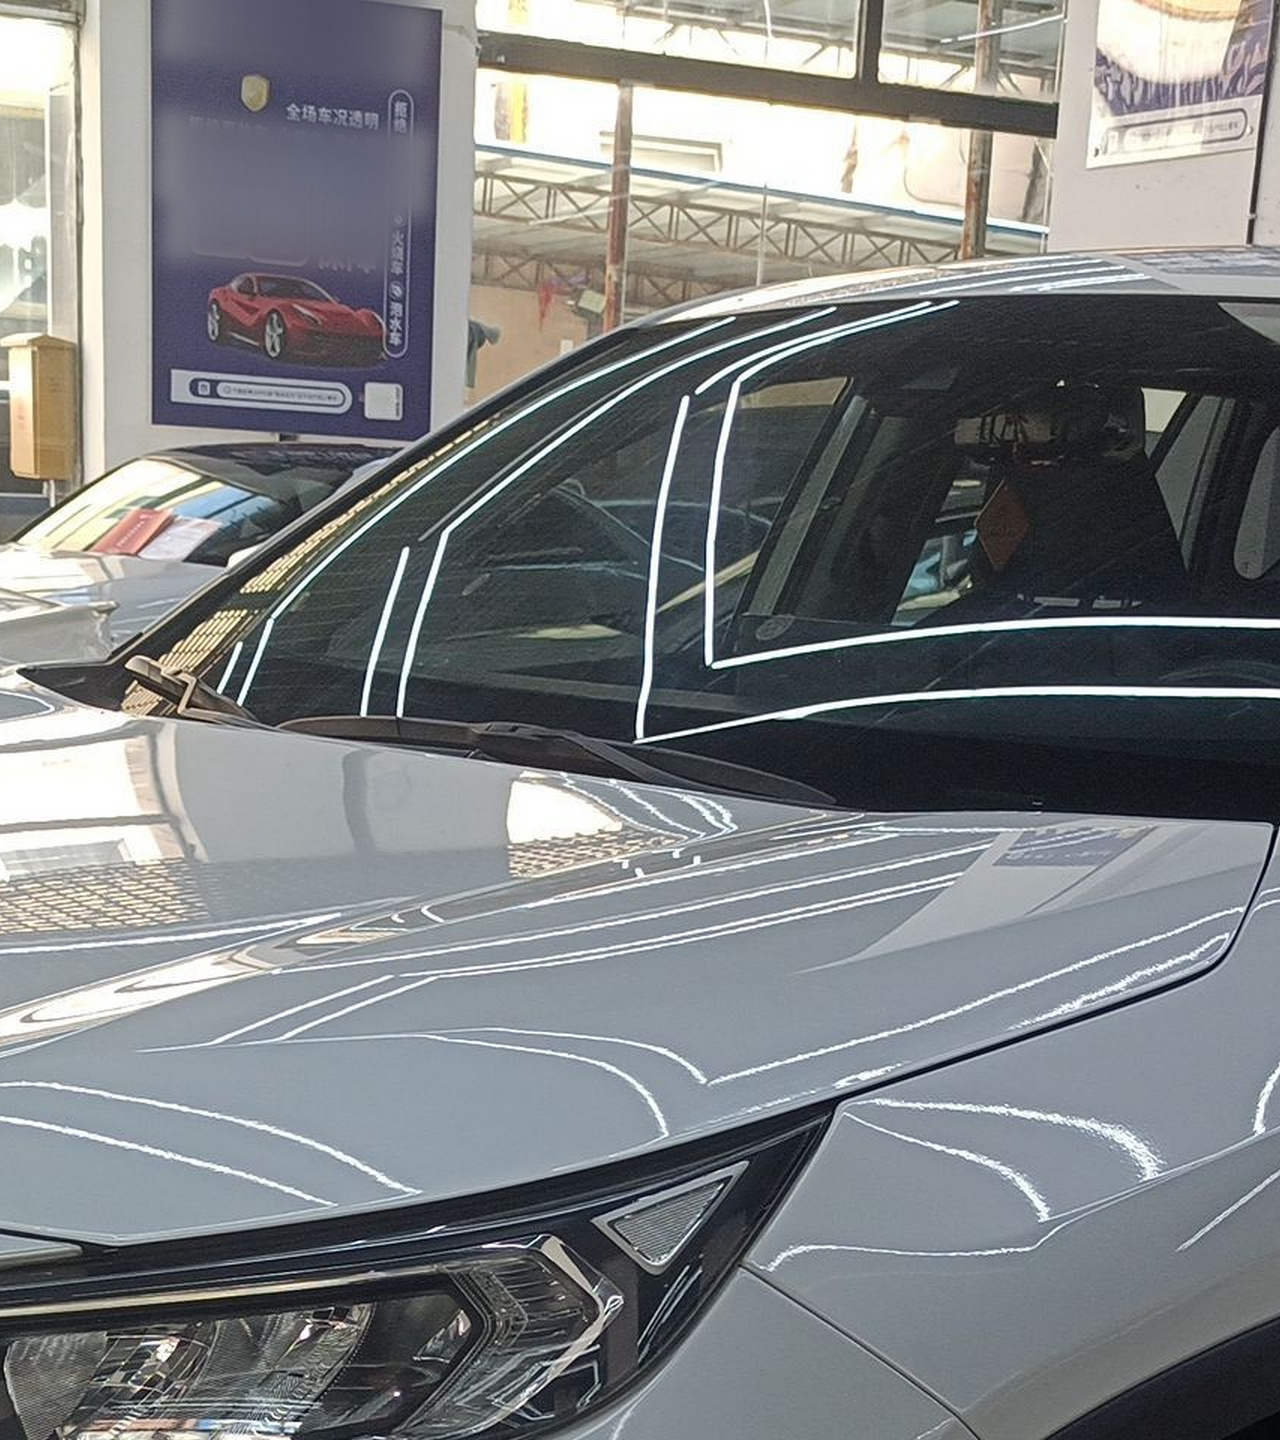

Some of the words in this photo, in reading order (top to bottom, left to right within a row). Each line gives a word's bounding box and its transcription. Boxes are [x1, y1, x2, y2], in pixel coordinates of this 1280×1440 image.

[286, 103, 379, 130] 全场车况透明
